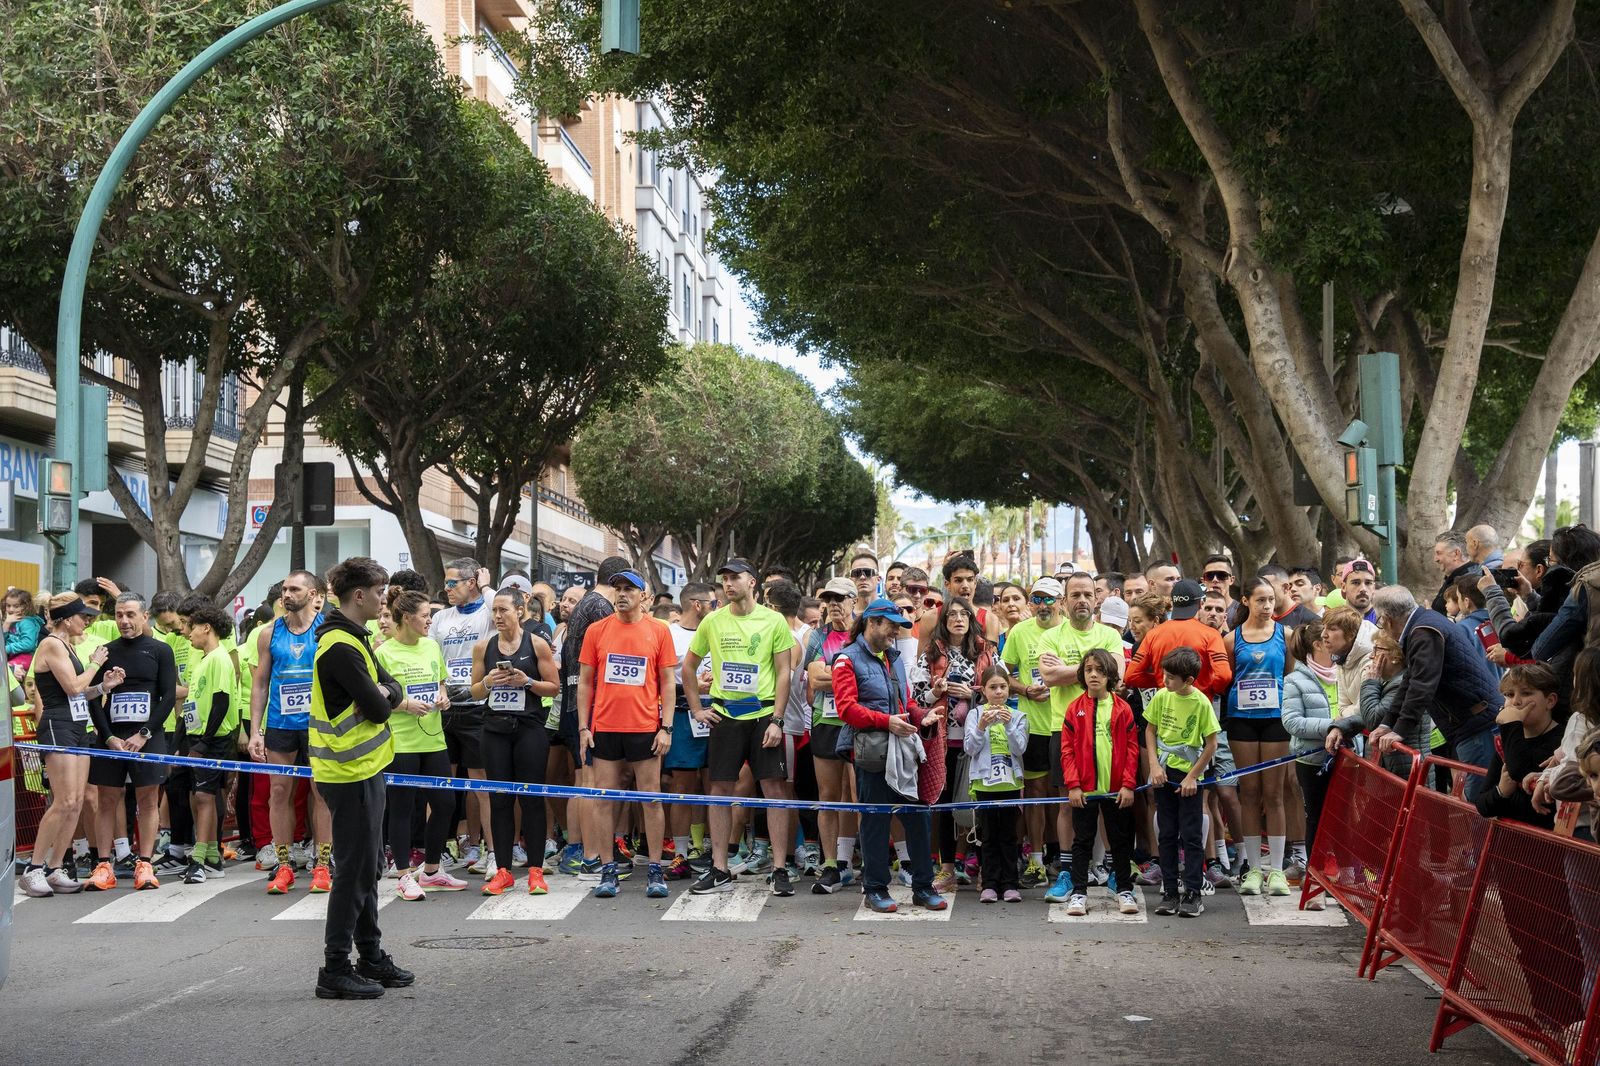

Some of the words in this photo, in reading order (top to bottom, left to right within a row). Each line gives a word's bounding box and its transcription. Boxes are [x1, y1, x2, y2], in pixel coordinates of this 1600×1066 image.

[0, 443, 51, 493] BAN
[443, 635, 479, 646] MICHLIN
[613, 665, 639, 677] 359
[726, 673, 752, 684] 358
[287, 694, 312, 706] 621
[494, 692, 518, 703] 292
[1249, 690, 1267, 701] 53
[113, 704, 148, 714] 1113
[993, 765, 1007, 777] 31
